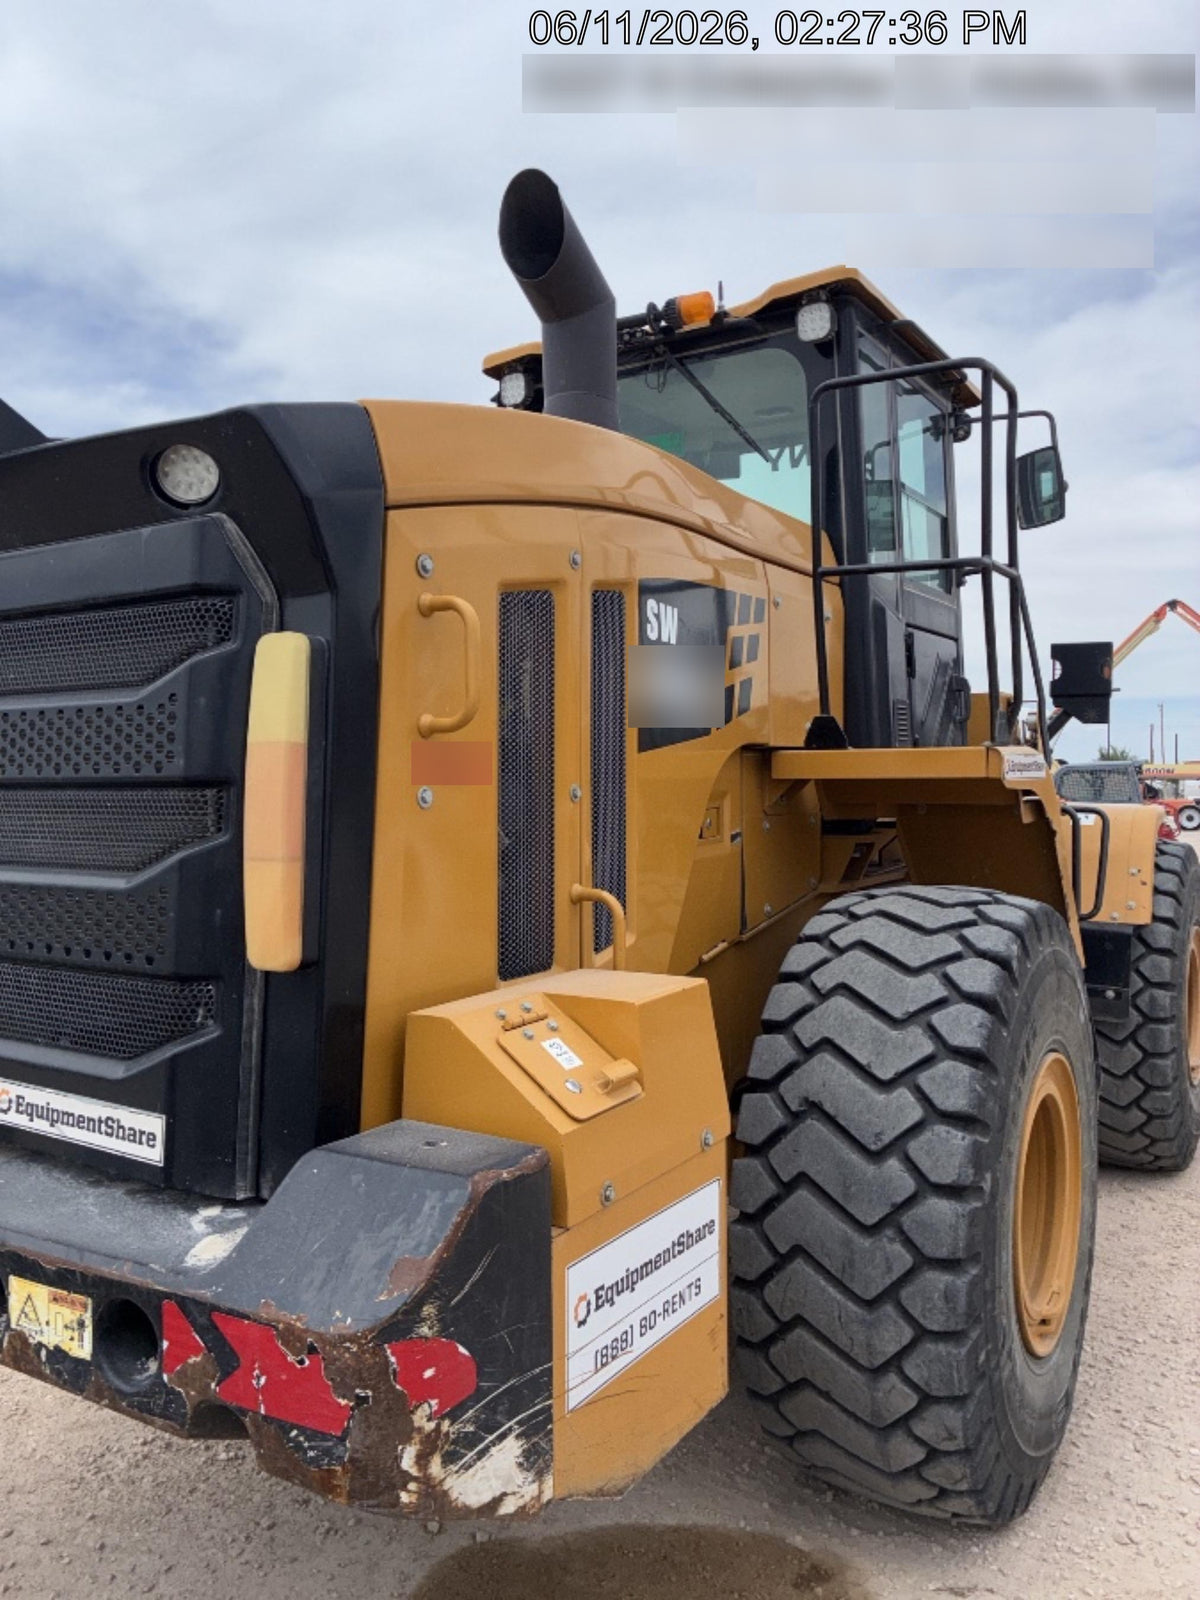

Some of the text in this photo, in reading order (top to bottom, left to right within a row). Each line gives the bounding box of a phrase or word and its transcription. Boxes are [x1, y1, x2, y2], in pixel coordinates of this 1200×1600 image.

[646, 598, 679, 645] SW
[15, 1095, 157, 1148] EquipmentShare
[593, 1218, 716, 1312] EquipmentShare
